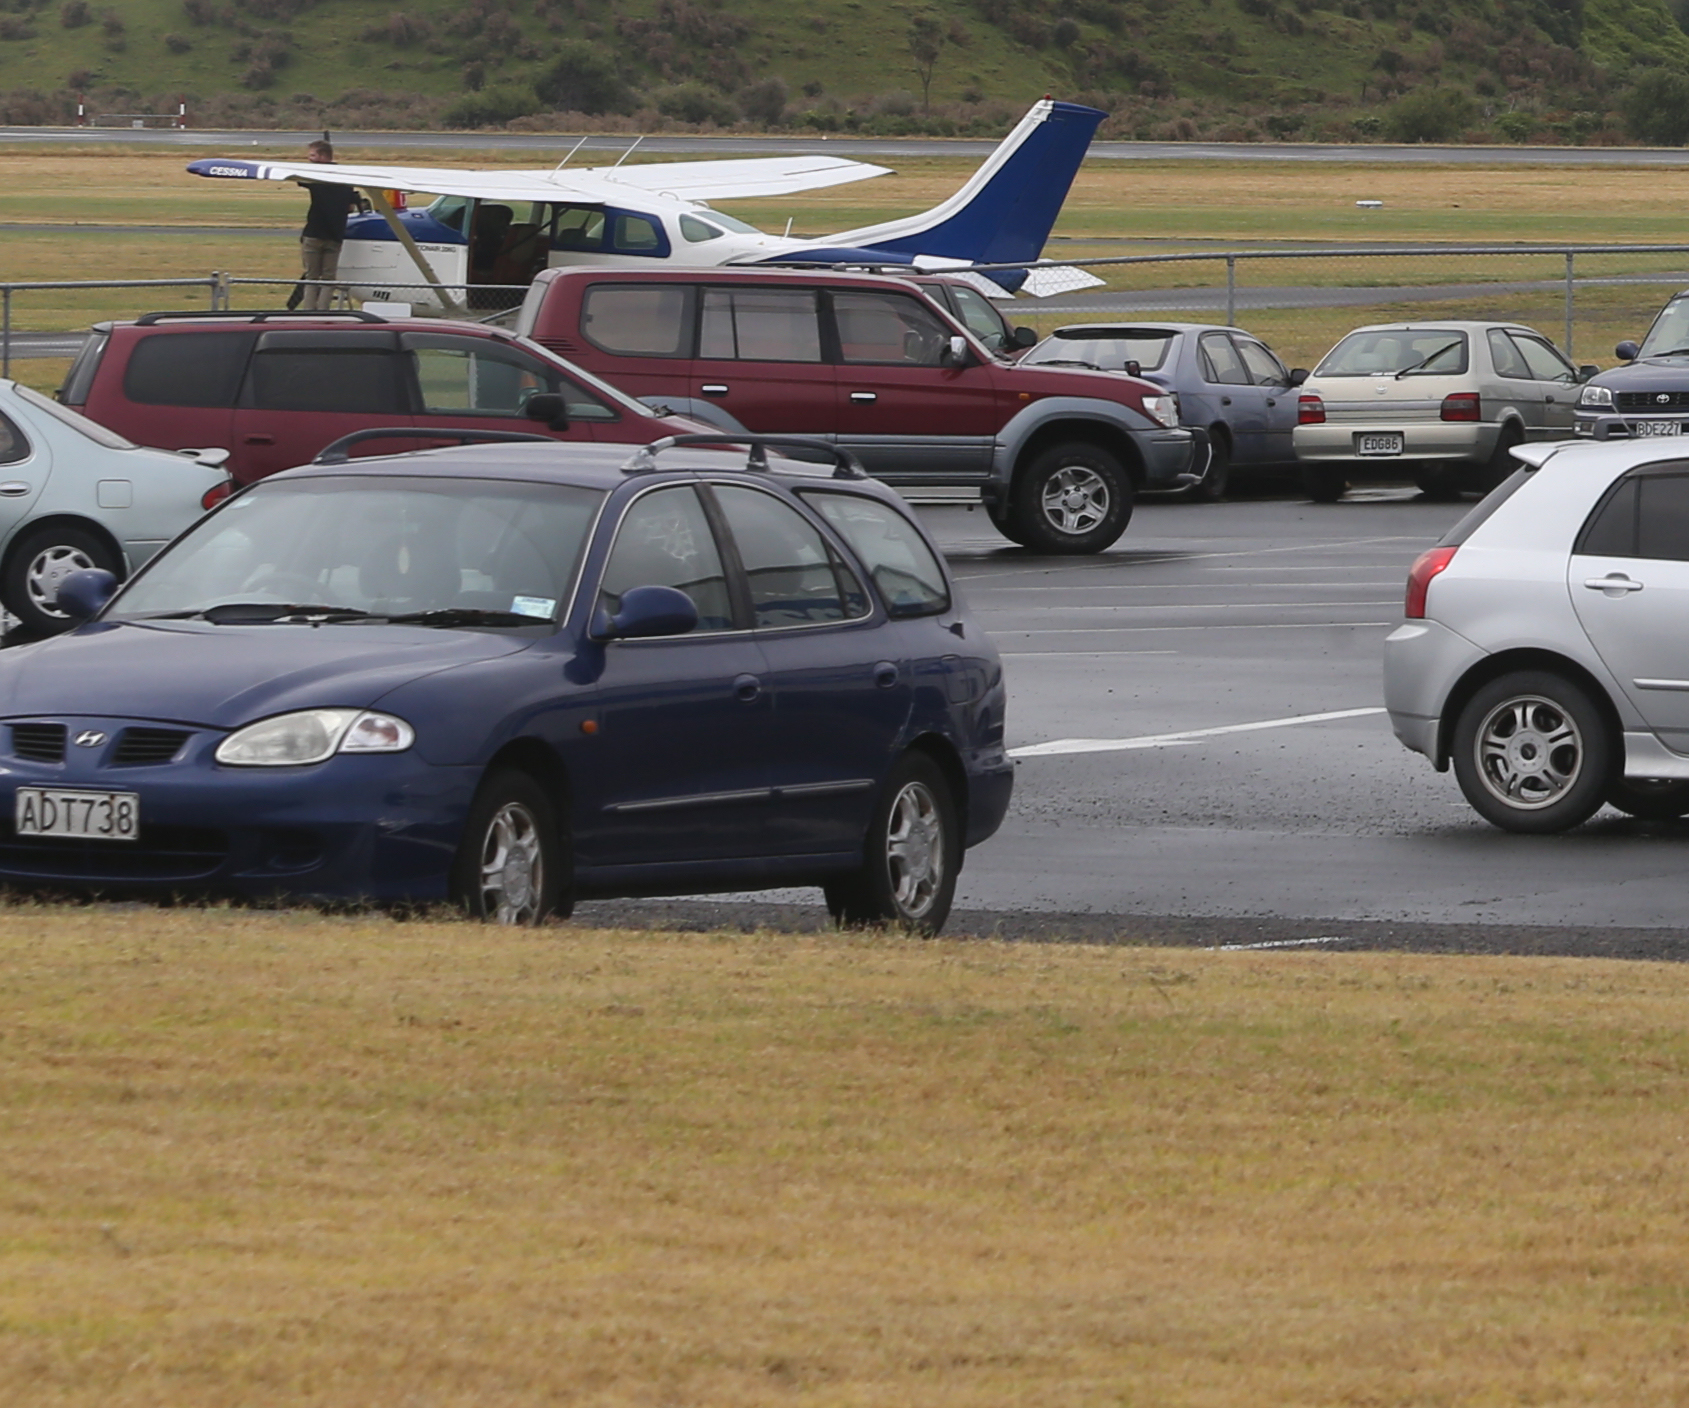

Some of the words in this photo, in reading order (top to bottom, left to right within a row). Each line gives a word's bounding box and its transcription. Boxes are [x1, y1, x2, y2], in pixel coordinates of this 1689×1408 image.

[209, 166, 248, 177] CESSNA
[1637, 422, 1681, 437] BDE227
[21, 796, 133, 834] ADT738
